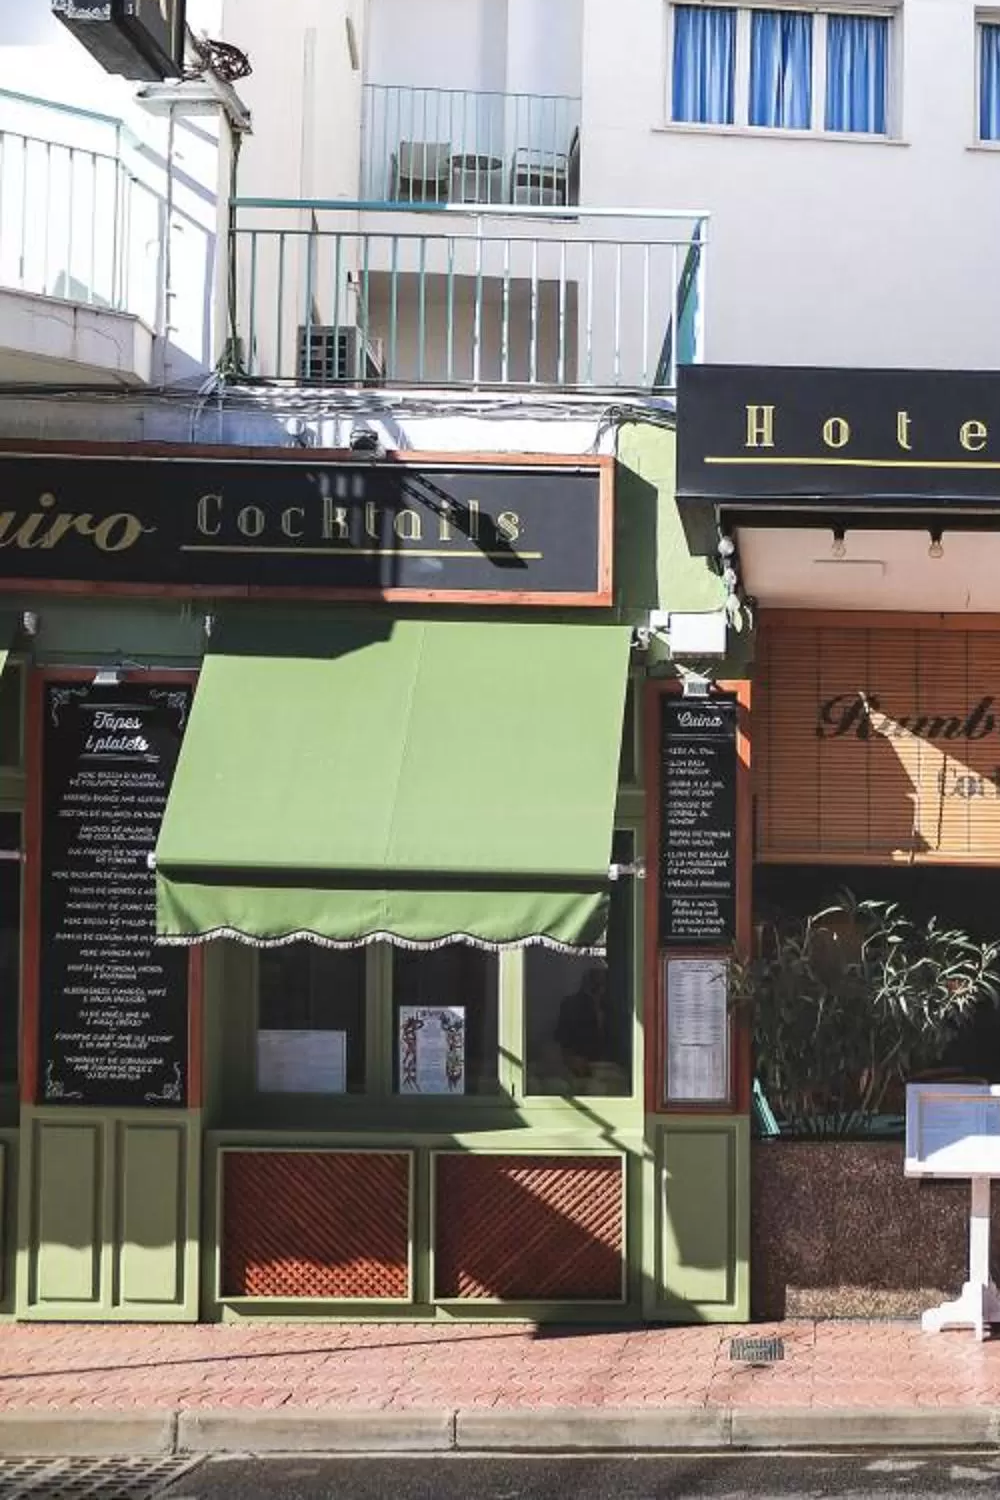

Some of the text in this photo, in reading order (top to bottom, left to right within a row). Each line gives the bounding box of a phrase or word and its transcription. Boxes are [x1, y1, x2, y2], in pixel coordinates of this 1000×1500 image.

[197, 494, 525, 542] Cocktails
[93, 711, 142, 731] Tapes
[677, 711, 723, 727] Cuina
